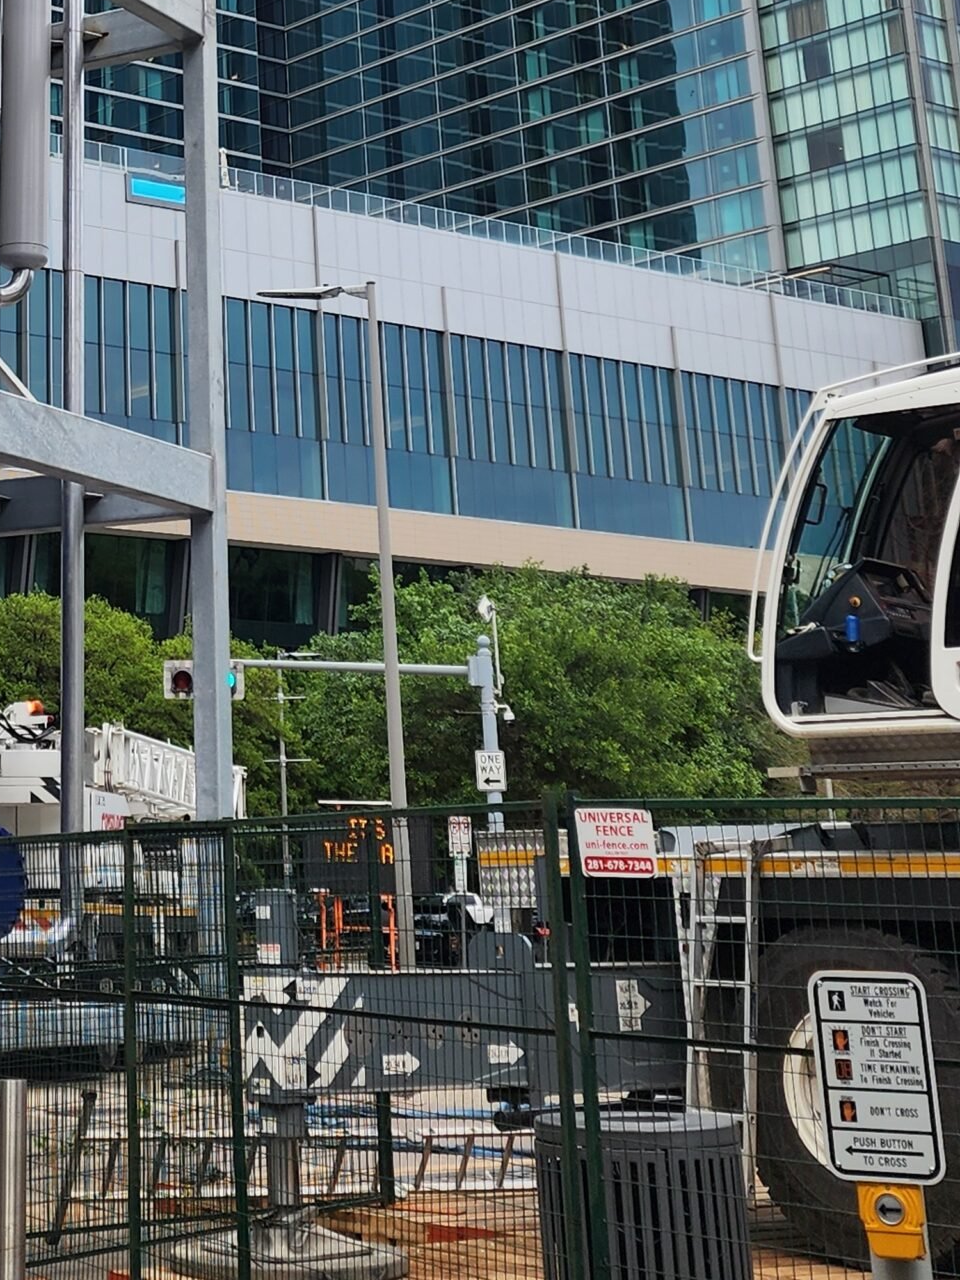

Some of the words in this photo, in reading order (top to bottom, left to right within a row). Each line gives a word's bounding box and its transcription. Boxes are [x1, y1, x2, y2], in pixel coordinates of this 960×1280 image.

[481, 755, 501, 764] ONE
[481, 766, 501, 774] WAY
[580, 812, 648, 823] UNIVERSAL
[595, 825, 634, 836] FENCE
[585, 840, 648, 850] uni-fence.com
[324, 841, 358, 863] THE
[586, 859, 652, 871] 281-678-7344
[850, 985, 870, 995] START
[874, 987, 910, 997] CROSSING
[887, 999, 897, 1008] For
[868, 1009, 895, 1019] Vehicles
[861, 1026, 882, 1036] DON'T
[886, 1027, 907, 1036] START
[860, 1038, 880, 1047] Finish
[883, 1039, 912, 1051] Crossing
[878, 1049, 902, 1059] Started
[860, 1063, 877, 1073] TIME
[880, 1064, 921, 1075] REMAINING
[860, 1075, 868, 1084] To
[871, 1075, 892, 1085] Finish
[895, 1076, 924, 1089] Crossing
[869, 1106, 891, 1117] DON'T
[895, 1108, 919, 1118] CROSS
[853, 1136, 877, 1148] PUSH
[880, 1138, 914, 1150] BUTTON
[863, 1155, 875, 1166] TO
[878, 1156, 908, 1168] CROSS
